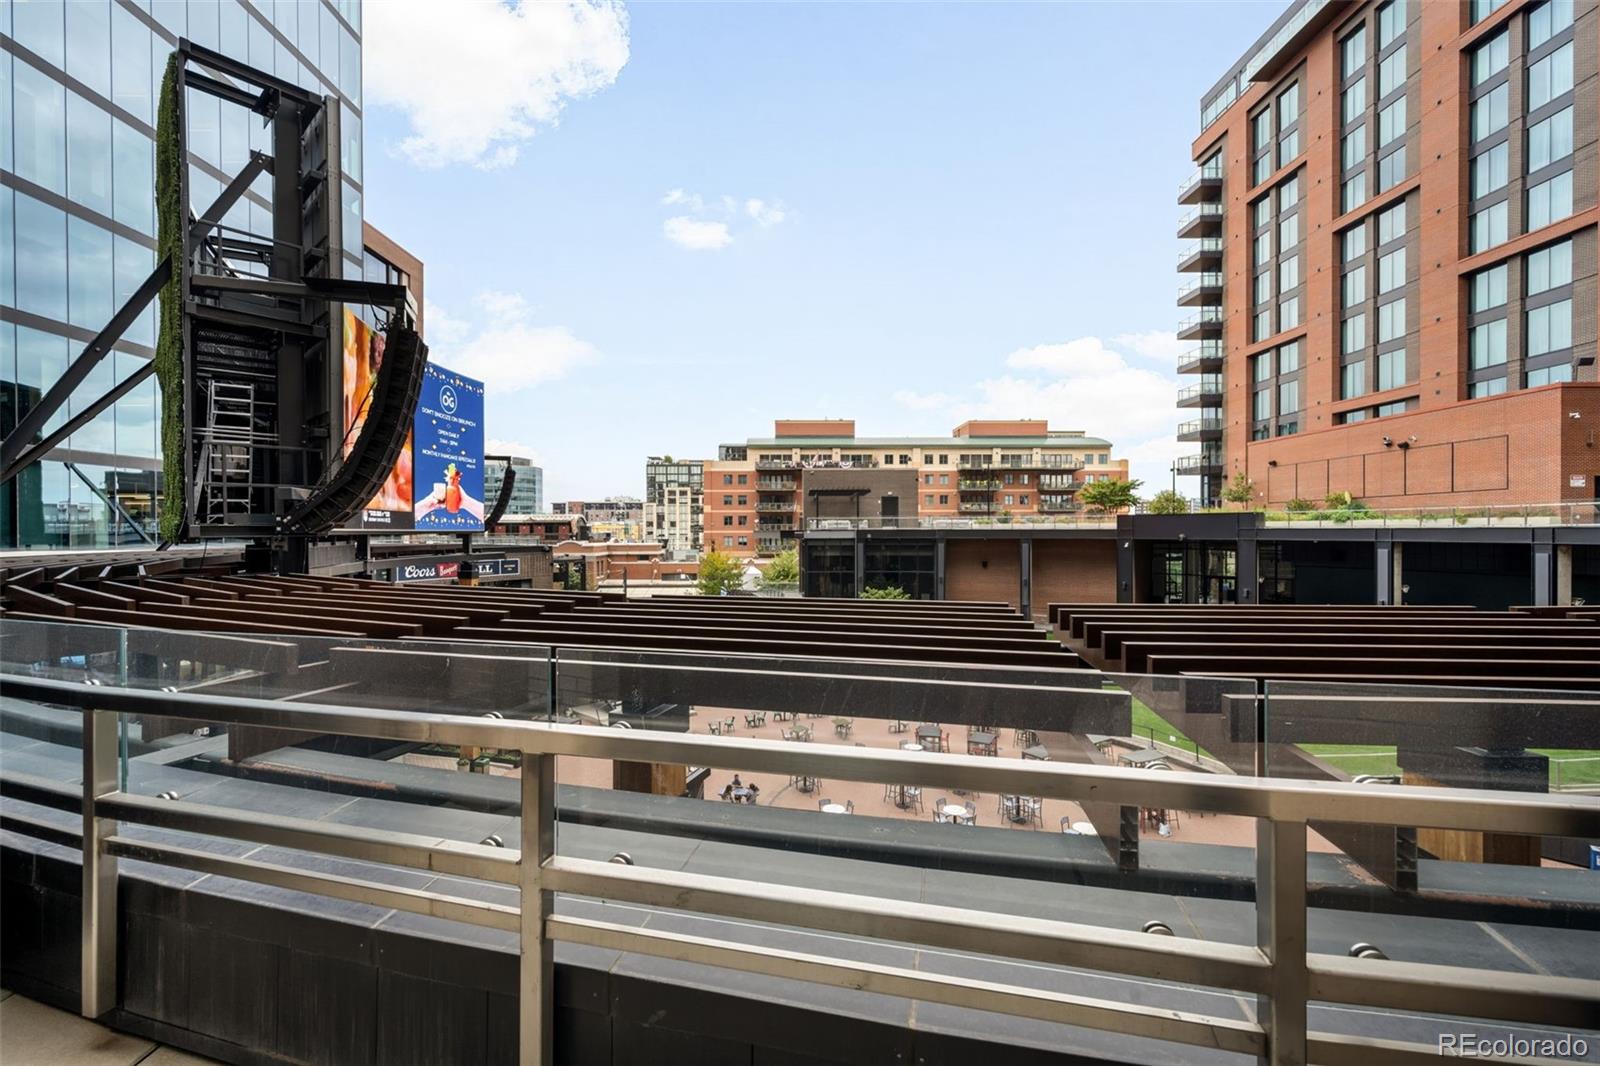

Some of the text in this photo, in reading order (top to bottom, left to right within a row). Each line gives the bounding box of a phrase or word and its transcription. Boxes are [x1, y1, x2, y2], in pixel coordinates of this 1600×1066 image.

[442, 394, 454, 408] OG
[458, 418, 476, 427] BRUNCH
[404, 565, 435, 578] Coors
